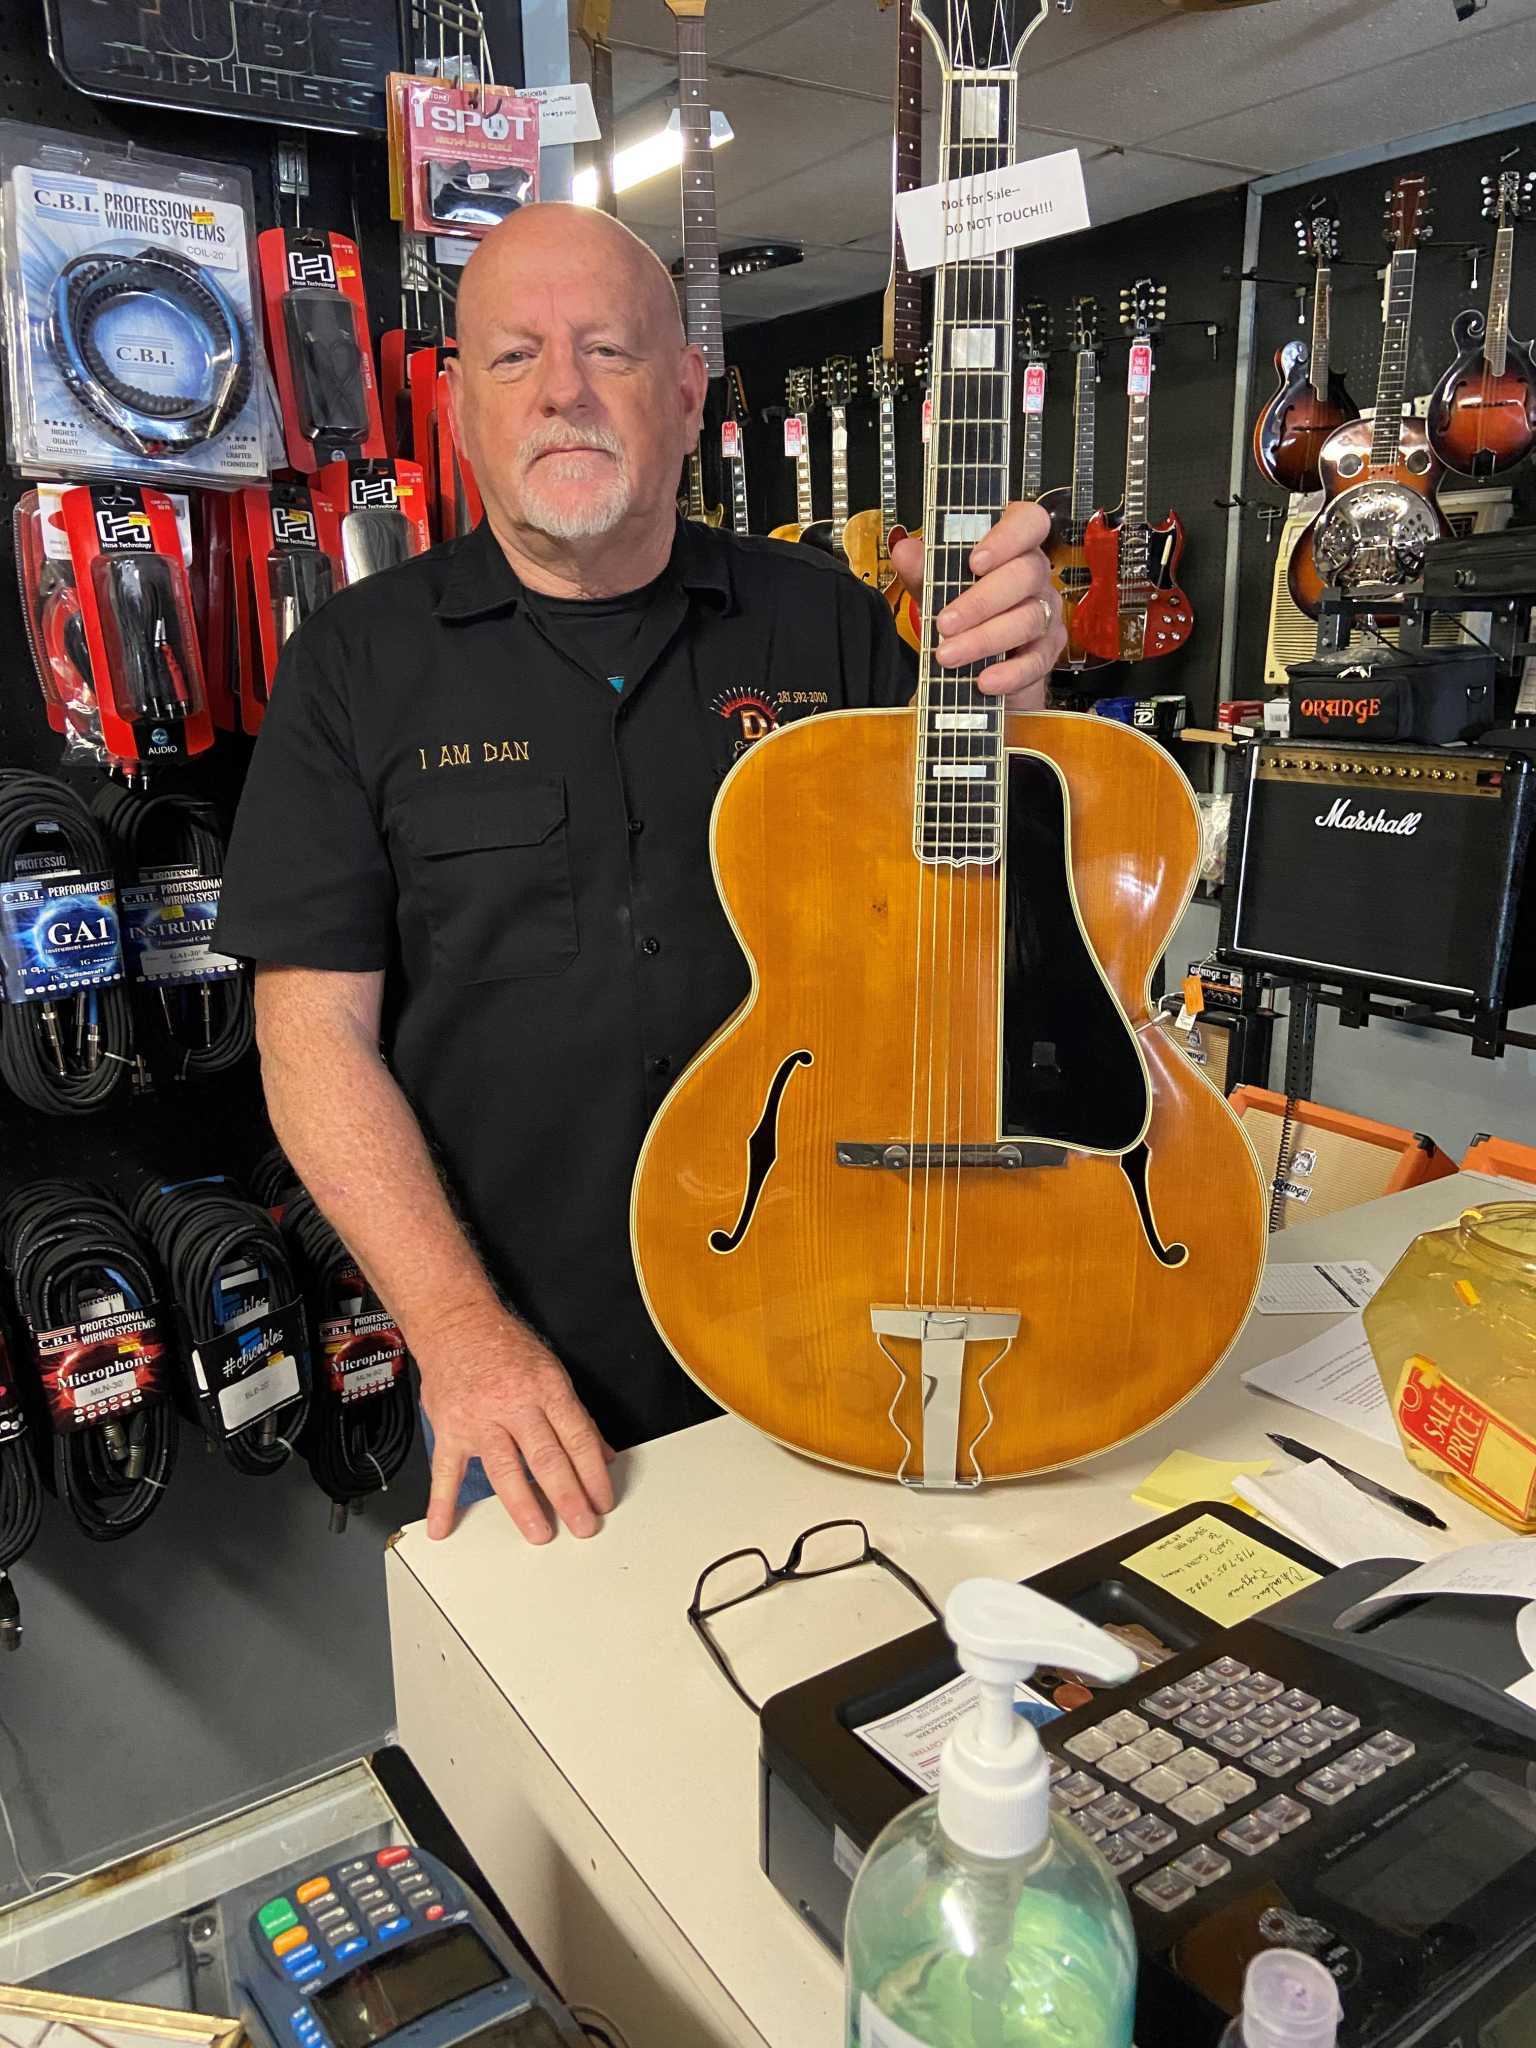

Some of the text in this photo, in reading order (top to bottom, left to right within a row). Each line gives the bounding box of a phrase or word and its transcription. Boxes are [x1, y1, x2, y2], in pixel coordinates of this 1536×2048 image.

[34, 190, 99, 212] C.B.I.
[941, 199, 964, 211] Not
[967, 194, 984, 206] for
[105, 211, 226, 243] WIRING SYSTEMS
[945, 200, 1054, 237] DO NOT TOUCH!!!
[307, 280, 336, 288] Technology
[116, 346, 174, 366] C.B.I.
[52, 438, 79, 446] QUALITY
[102, 541, 152, 550] Hosa Technology
[289, 537, 317, 547] Technology
[777, 691, 828, 703] 281 592-2000
[1301, 698, 1382, 725] ORANGE
[148, 745, 178, 755] AUDIO
[419, 741, 530, 770] I AM DAN
[1315, 798, 1423, 836] Marshall
[2, 889, 44, 904] C.B.I.
[48, 881, 100, 898] PERFORMER
[121, 892, 159, 904] C.B.I.
[162, 894, 196, 906] WIRING
[48, 917, 110, 945] GA1
[80, 1310, 146, 1334] PROFESSIONAL
[82, 1318, 156, 1345] WIRING SYSTEMS
[354, 1322, 381, 1336] WIRING
[38, 1334, 77, 1349] C.B.I.
[331, 1345, 407, 1375] Microphone
[57, 1354, 153, 1391] Microphone
[1422, 1391, 1457, 1445] SALE
[1446, 1404, 1484, 1469] PRICE
